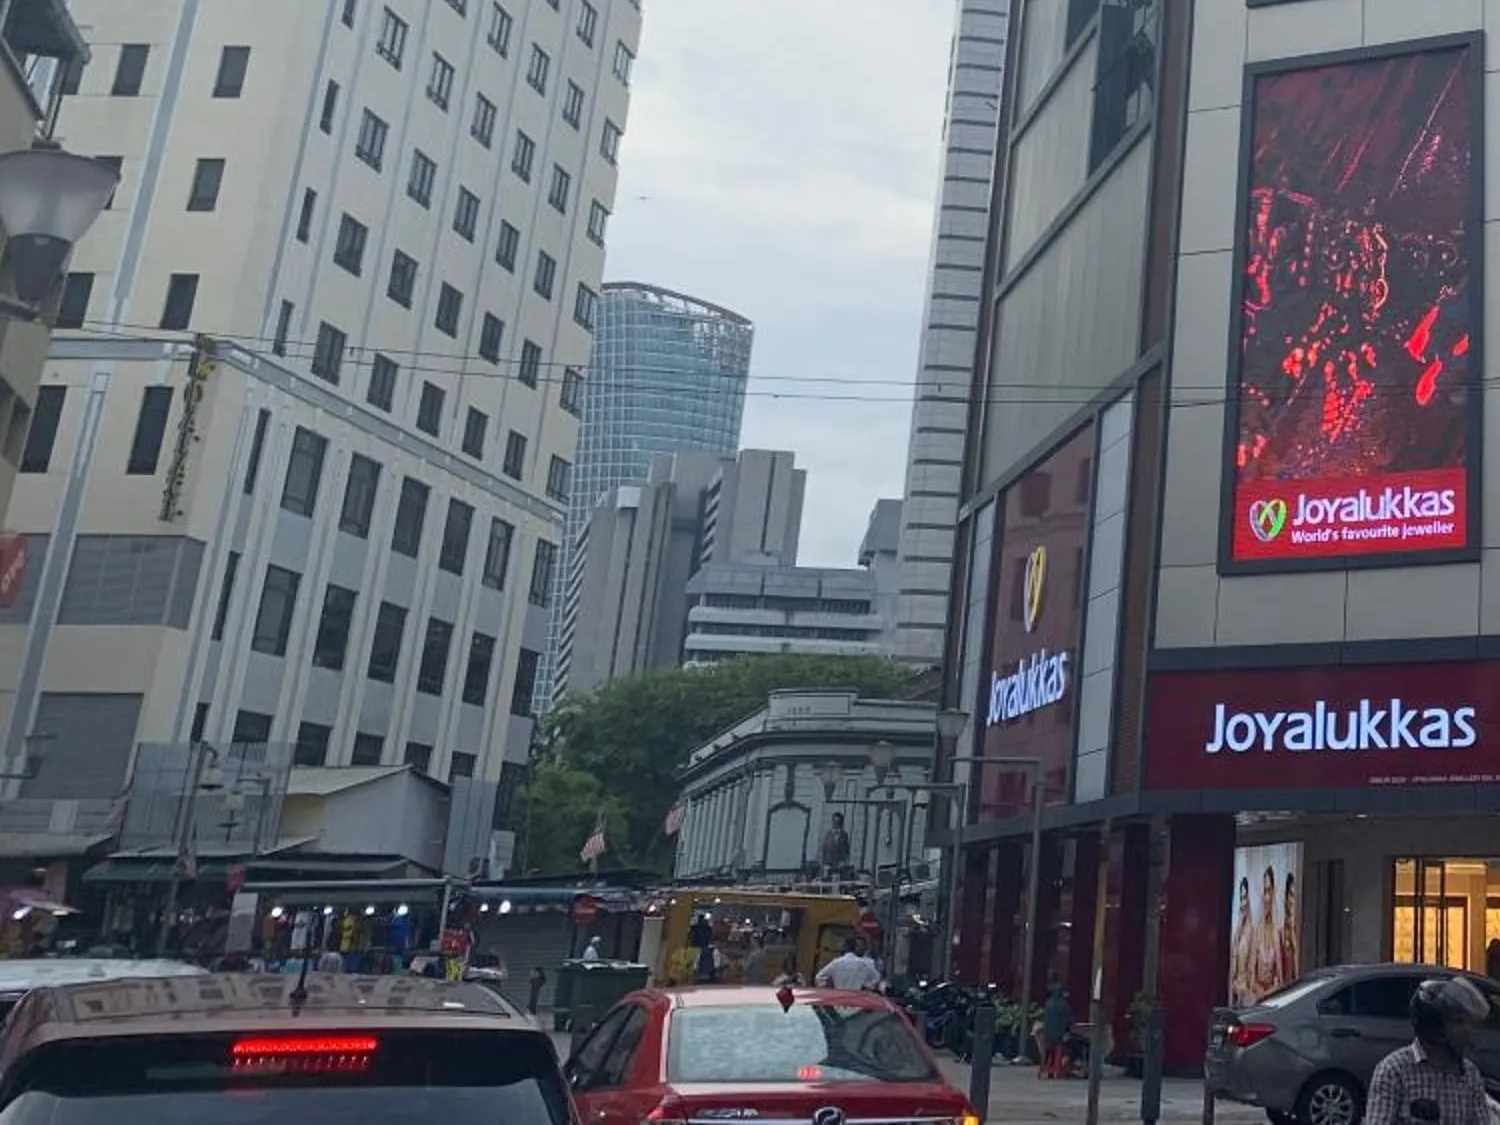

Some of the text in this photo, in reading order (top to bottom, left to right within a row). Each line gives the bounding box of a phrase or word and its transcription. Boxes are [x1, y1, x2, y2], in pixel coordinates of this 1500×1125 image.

[1293, 486, 1455, 526] Joyalukkas
[1291, 521, 1455, 543] World's favourite jeweller
[1205, 698, 1477, 754] Joyalukkas
